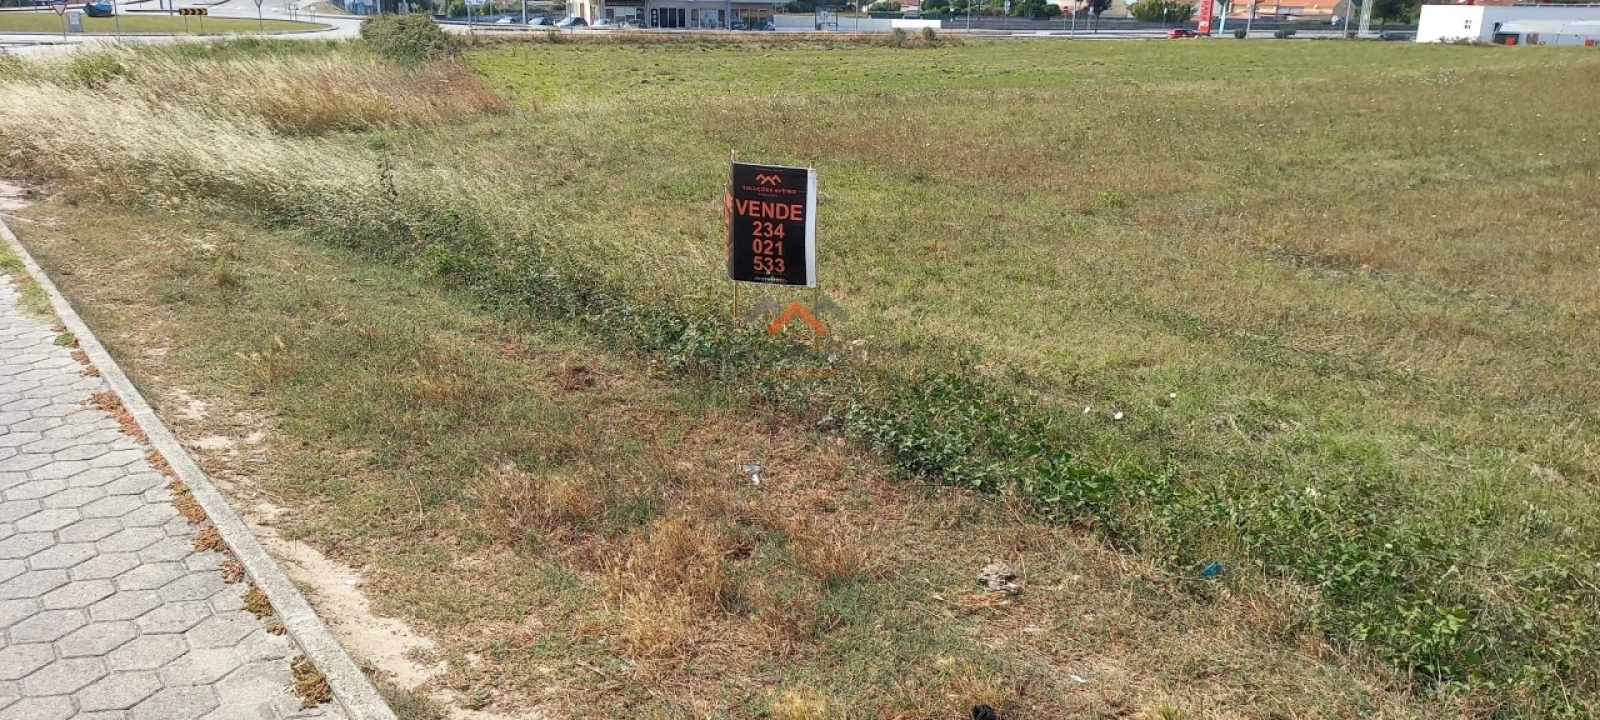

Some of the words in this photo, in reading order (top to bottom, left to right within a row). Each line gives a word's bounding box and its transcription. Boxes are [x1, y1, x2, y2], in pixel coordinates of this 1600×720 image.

[735, 199, 803, 221] VENDE
[752, 221, 785, 239] 234
[753, 239, 783, 255] 021
[753, 256, 785, 273] 533
